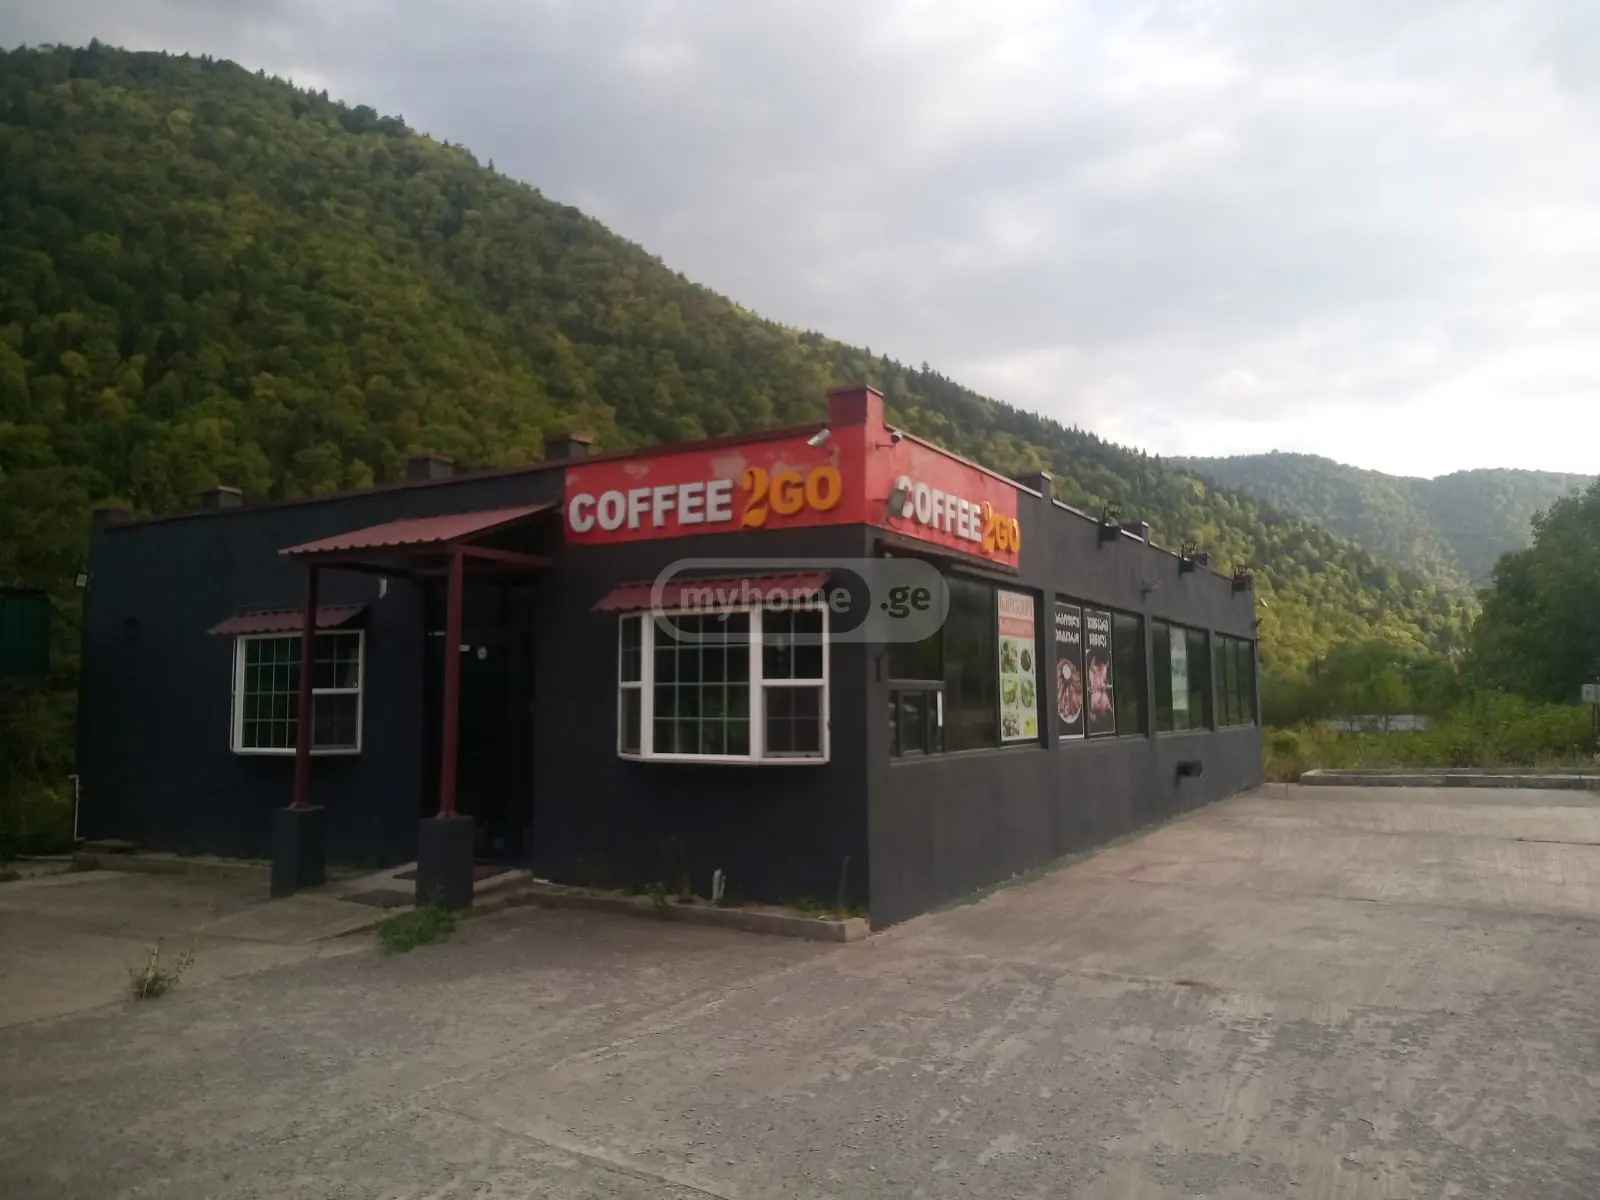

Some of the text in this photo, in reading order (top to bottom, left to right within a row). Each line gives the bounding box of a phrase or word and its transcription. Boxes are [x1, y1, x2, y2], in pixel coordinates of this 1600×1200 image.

[568, 465, 842, 533] COFFEE 2GO
[982, 500, 1021, 553] 2GO
